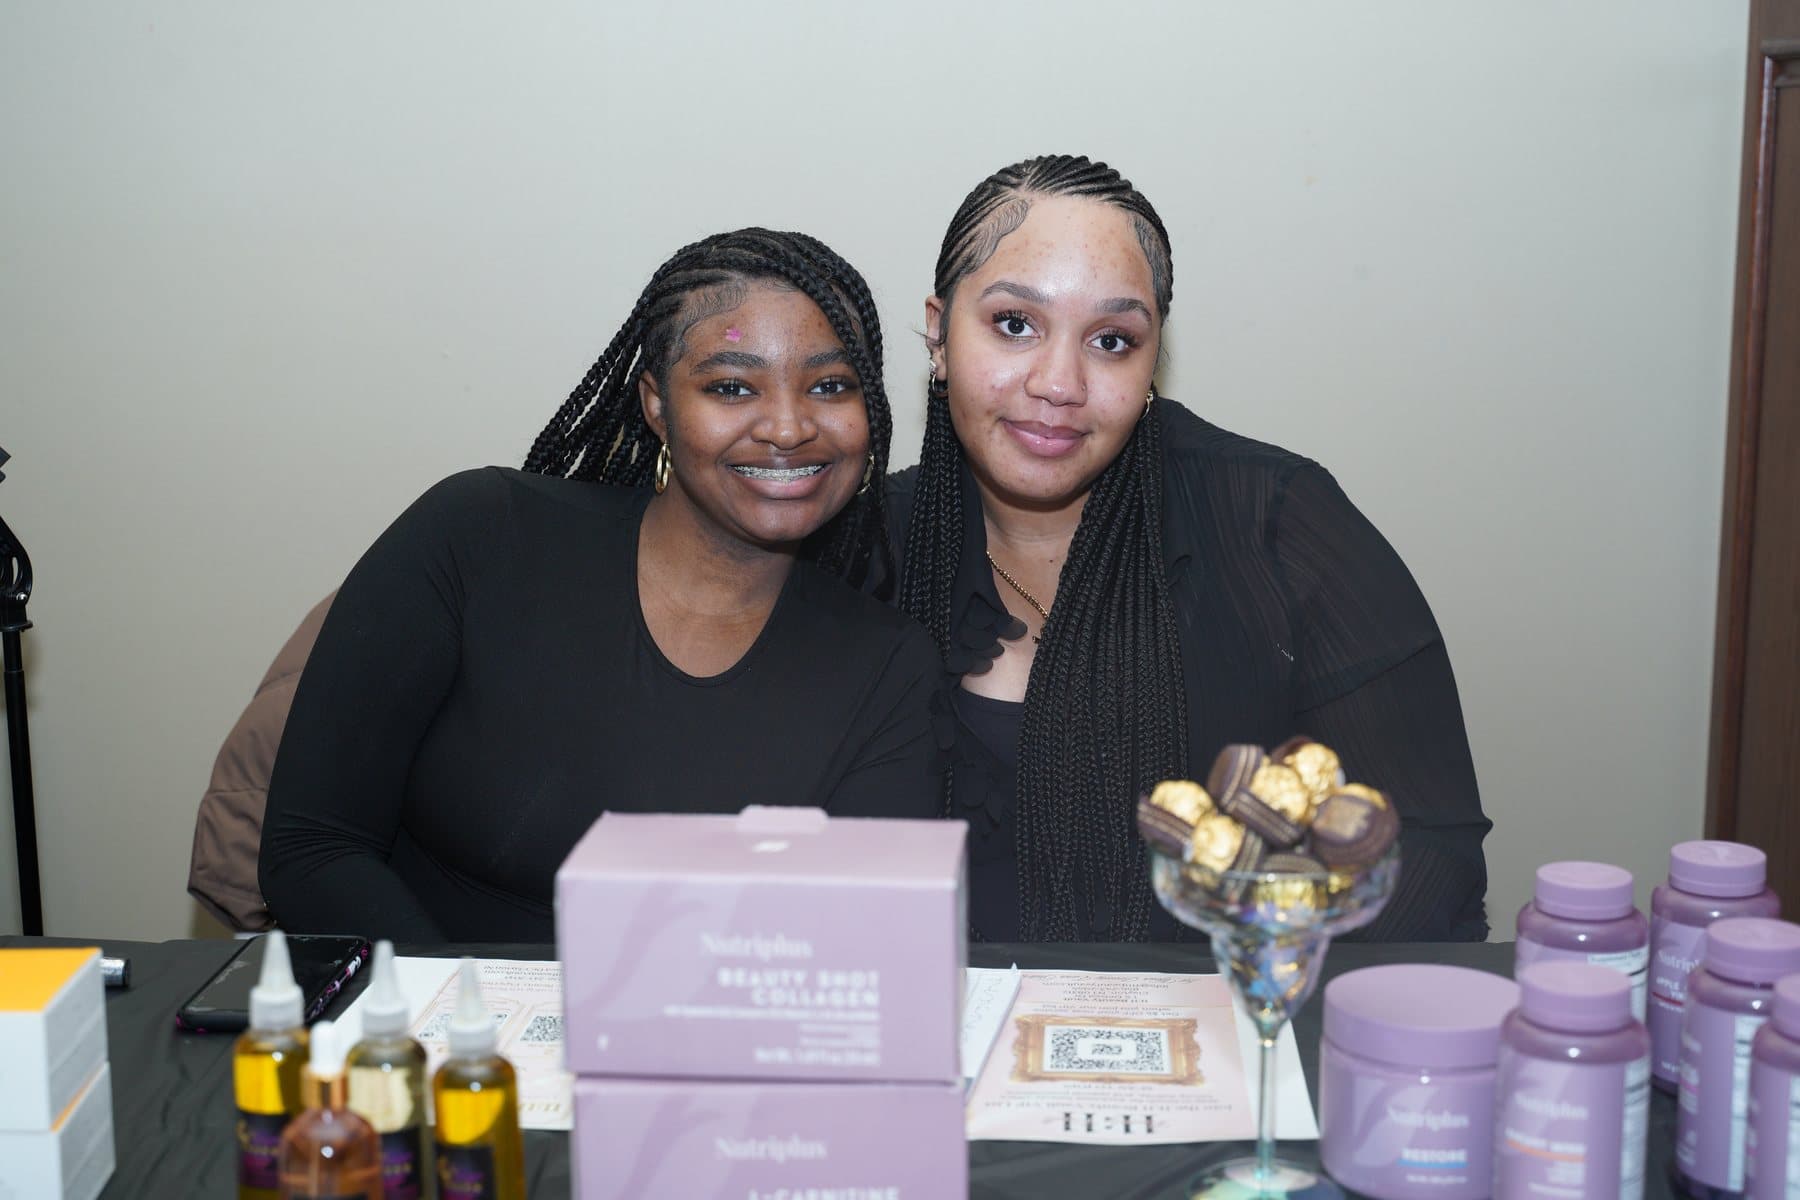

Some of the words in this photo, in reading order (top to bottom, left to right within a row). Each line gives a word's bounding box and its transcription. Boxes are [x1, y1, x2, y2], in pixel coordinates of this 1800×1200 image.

[701, 932, 812, 962] Nutriplus
[717, 967, 807, 987] BEAUTY
[817, 969, 880, 988] SHOT
[752, 987, 880, 1007] COLLAGEN
[1062, 1112, 1154, 1134] 11:11
[715, 1134, 827, 1163] Nutriplus
